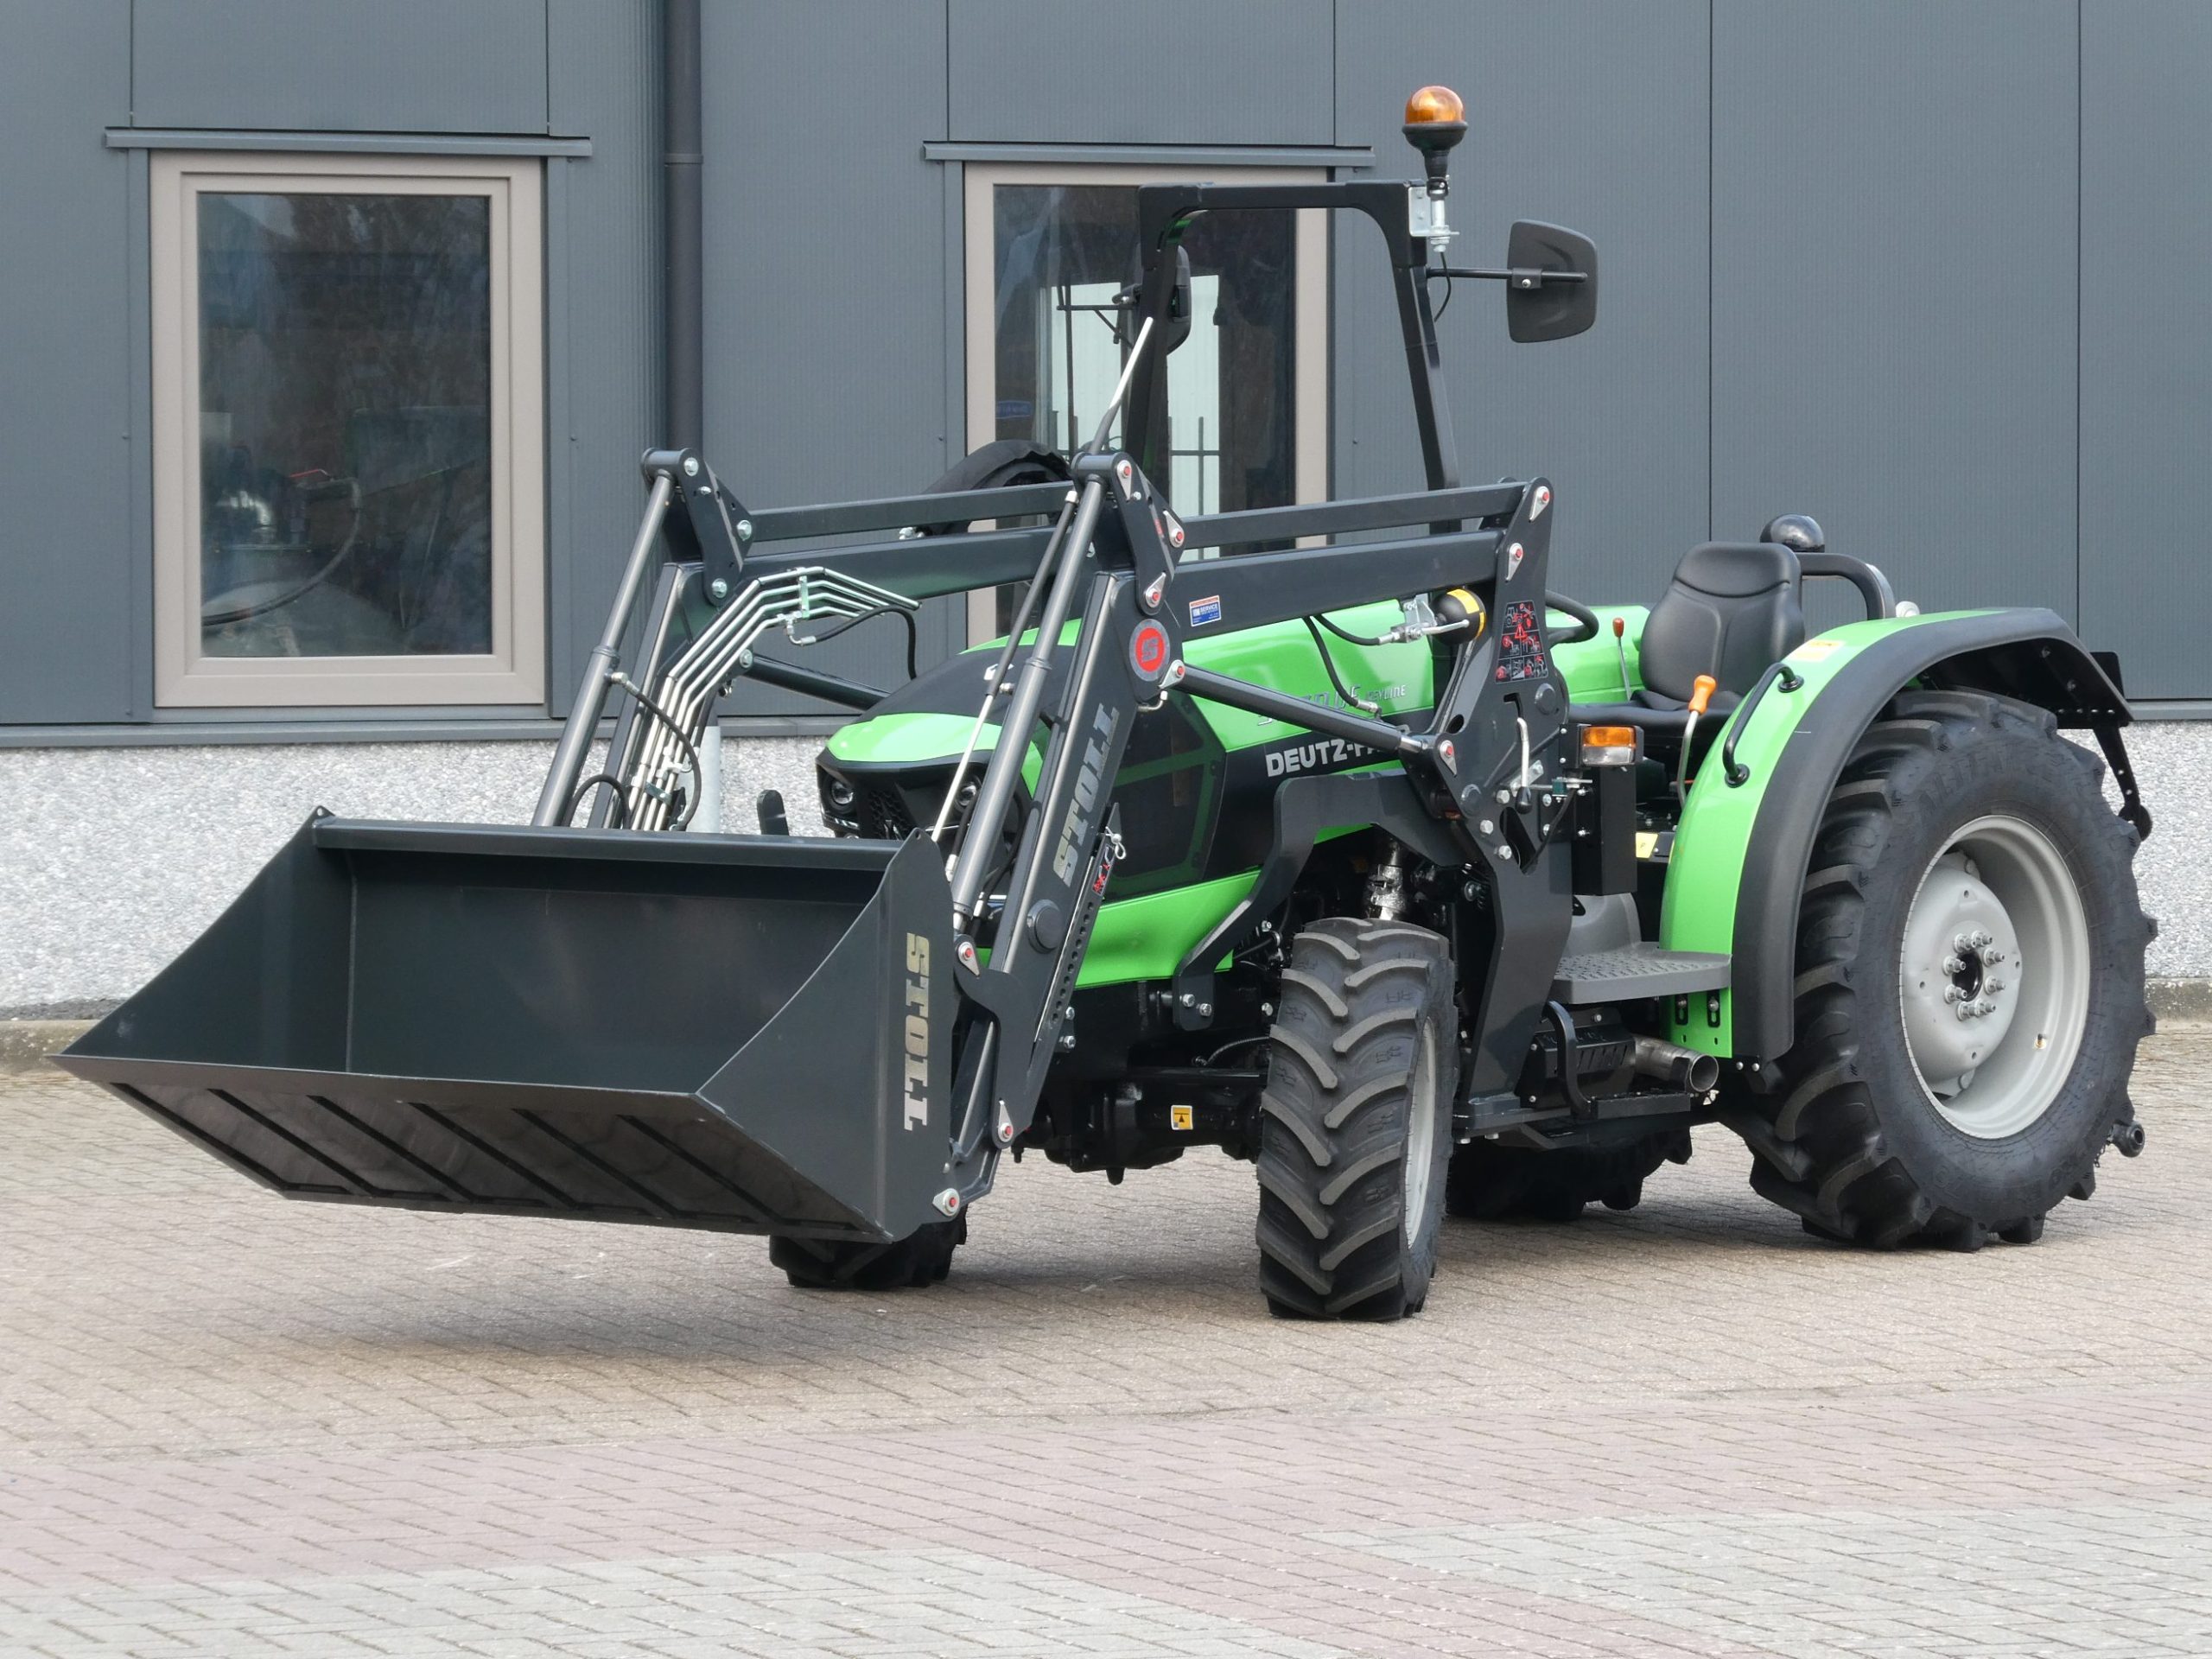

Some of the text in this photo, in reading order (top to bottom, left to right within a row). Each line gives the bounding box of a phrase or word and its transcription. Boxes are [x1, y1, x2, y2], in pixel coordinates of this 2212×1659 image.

[1052, 702, 1121, 888] STOLL
[1265, 738, 1384, 778] DEUTZ-F
[904, 932, 930, 1131] STOLL
